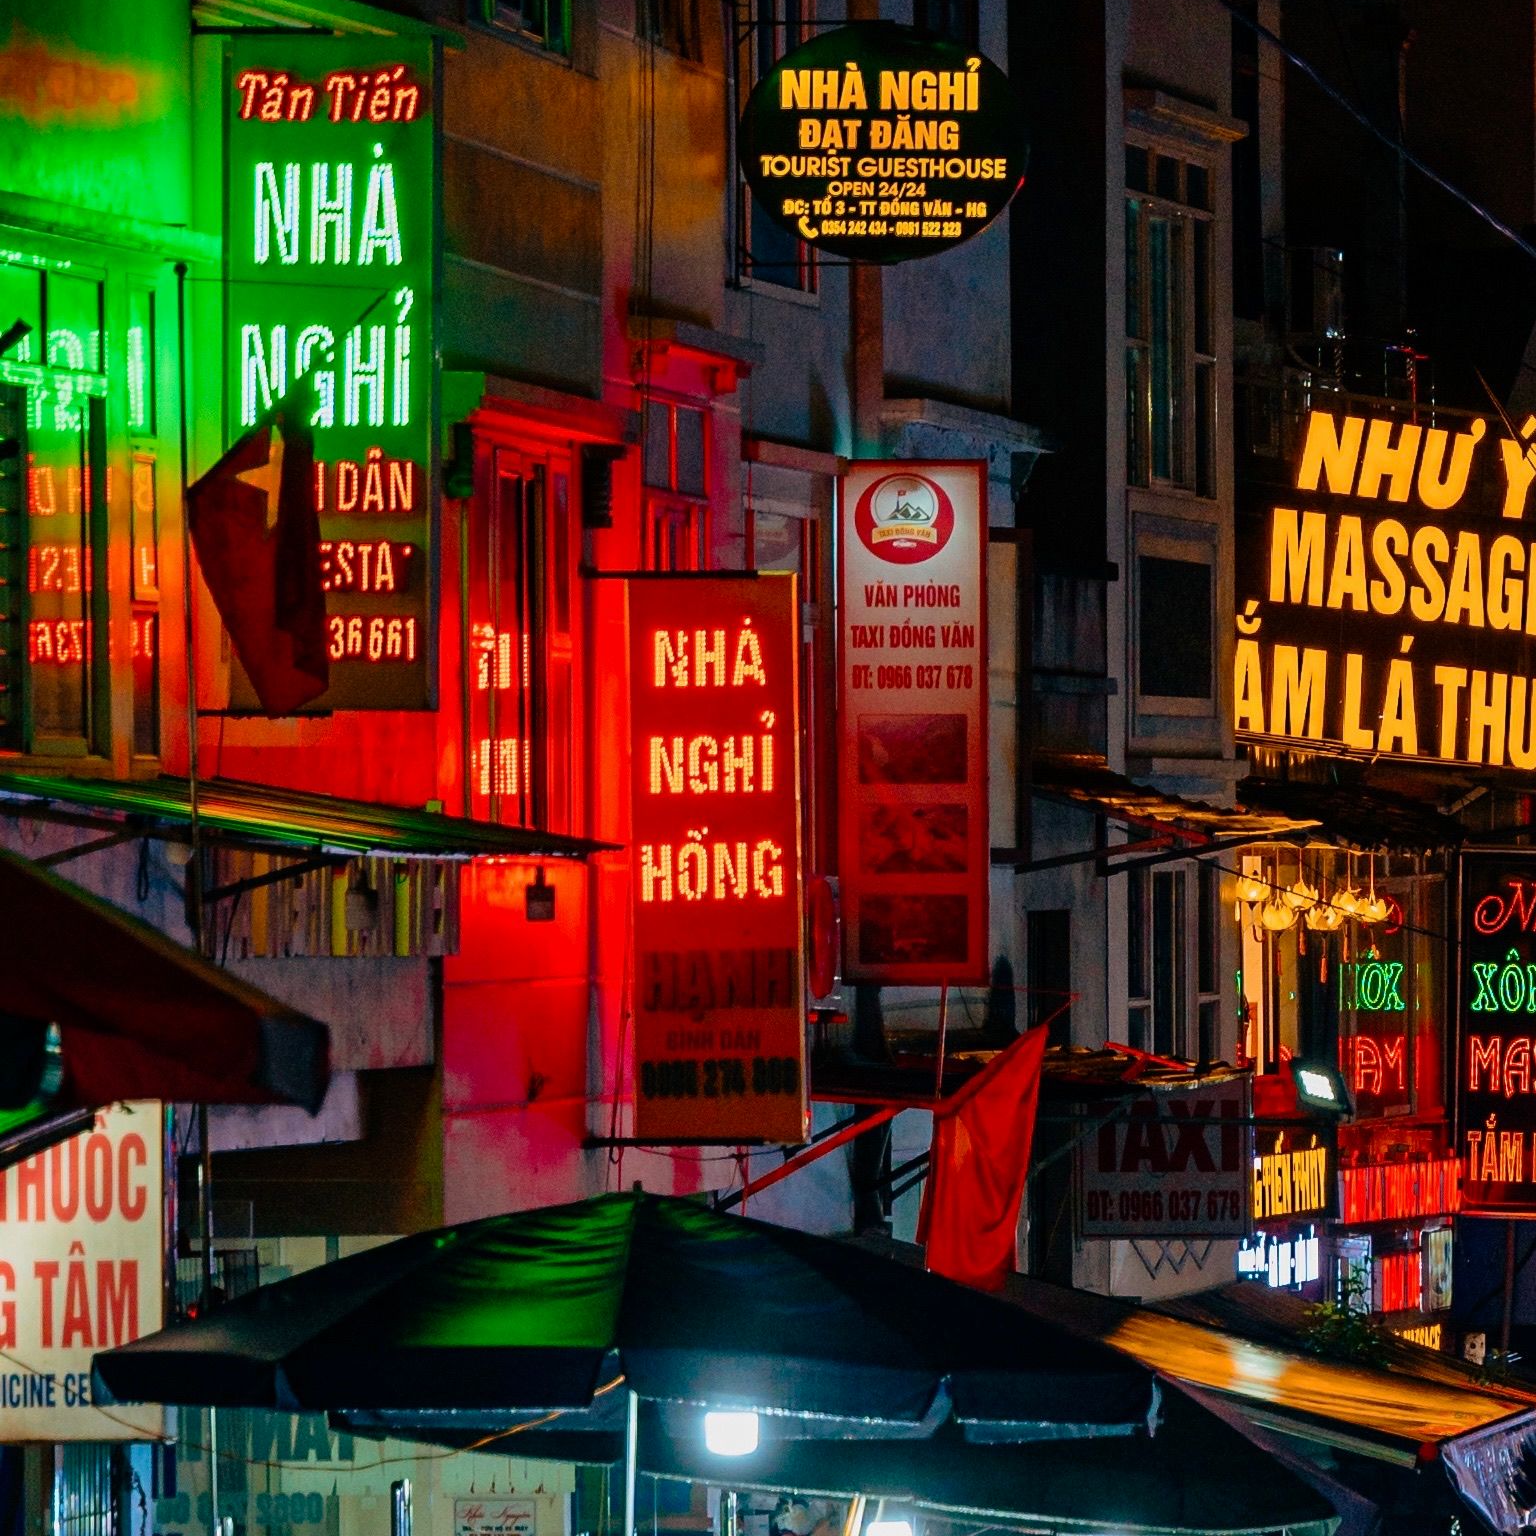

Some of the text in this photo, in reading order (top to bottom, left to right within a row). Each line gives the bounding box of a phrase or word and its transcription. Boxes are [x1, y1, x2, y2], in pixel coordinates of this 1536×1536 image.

[238, 64, 420, 123] Tân Tiến
[780, 57, 982, 112] NHÀ NGHỈ
[799, 114, 960, 155] ĐẠT ĐĂNG
[760, 155, 1008, 180] TOURIST GUESTHOUSE
[828, 181, 927, 199] OPEN 24/24
[253, 143, 403, 267] NHÀ
[783, 199, 810, 216] ĐC:
[835, 201, 846, 214] 3
[859, 201, 878, 216] TT
[923, 199, 952, 217] VĂN
[966, 202, 988, 218] HG
[239, 286, 416, 428] NGHỈ
[337, 448, 414, 513] DÂN
[1296, 410, 1486, 510] NHƯ
[864, 578, 961, 608] VĂN PHÒNG
[653, 616, 767, 688] NHÀ
[850, 625, 885, 648] TAXI
[941, 620, 975, 648] VĂN
[877, 665, 912, 689] 0966
[916, 665, 942, 689] 037
[946, 665, 973, 689] 678
[1341, 635, 1419, 757] LÁ
[648, 709, 777, 796] NGHỈ
[1087, 1100, 1240, 1173] TAXI
[1467, 1112, 1524, 1183] TẮM
[1119, 1191, 1163, 1222] 0966
[1168, 1191, 1202, 1221] 037
[1207, 1191, 1240, 1221] 678
[34, 1240, 140, 1351] TÂM
